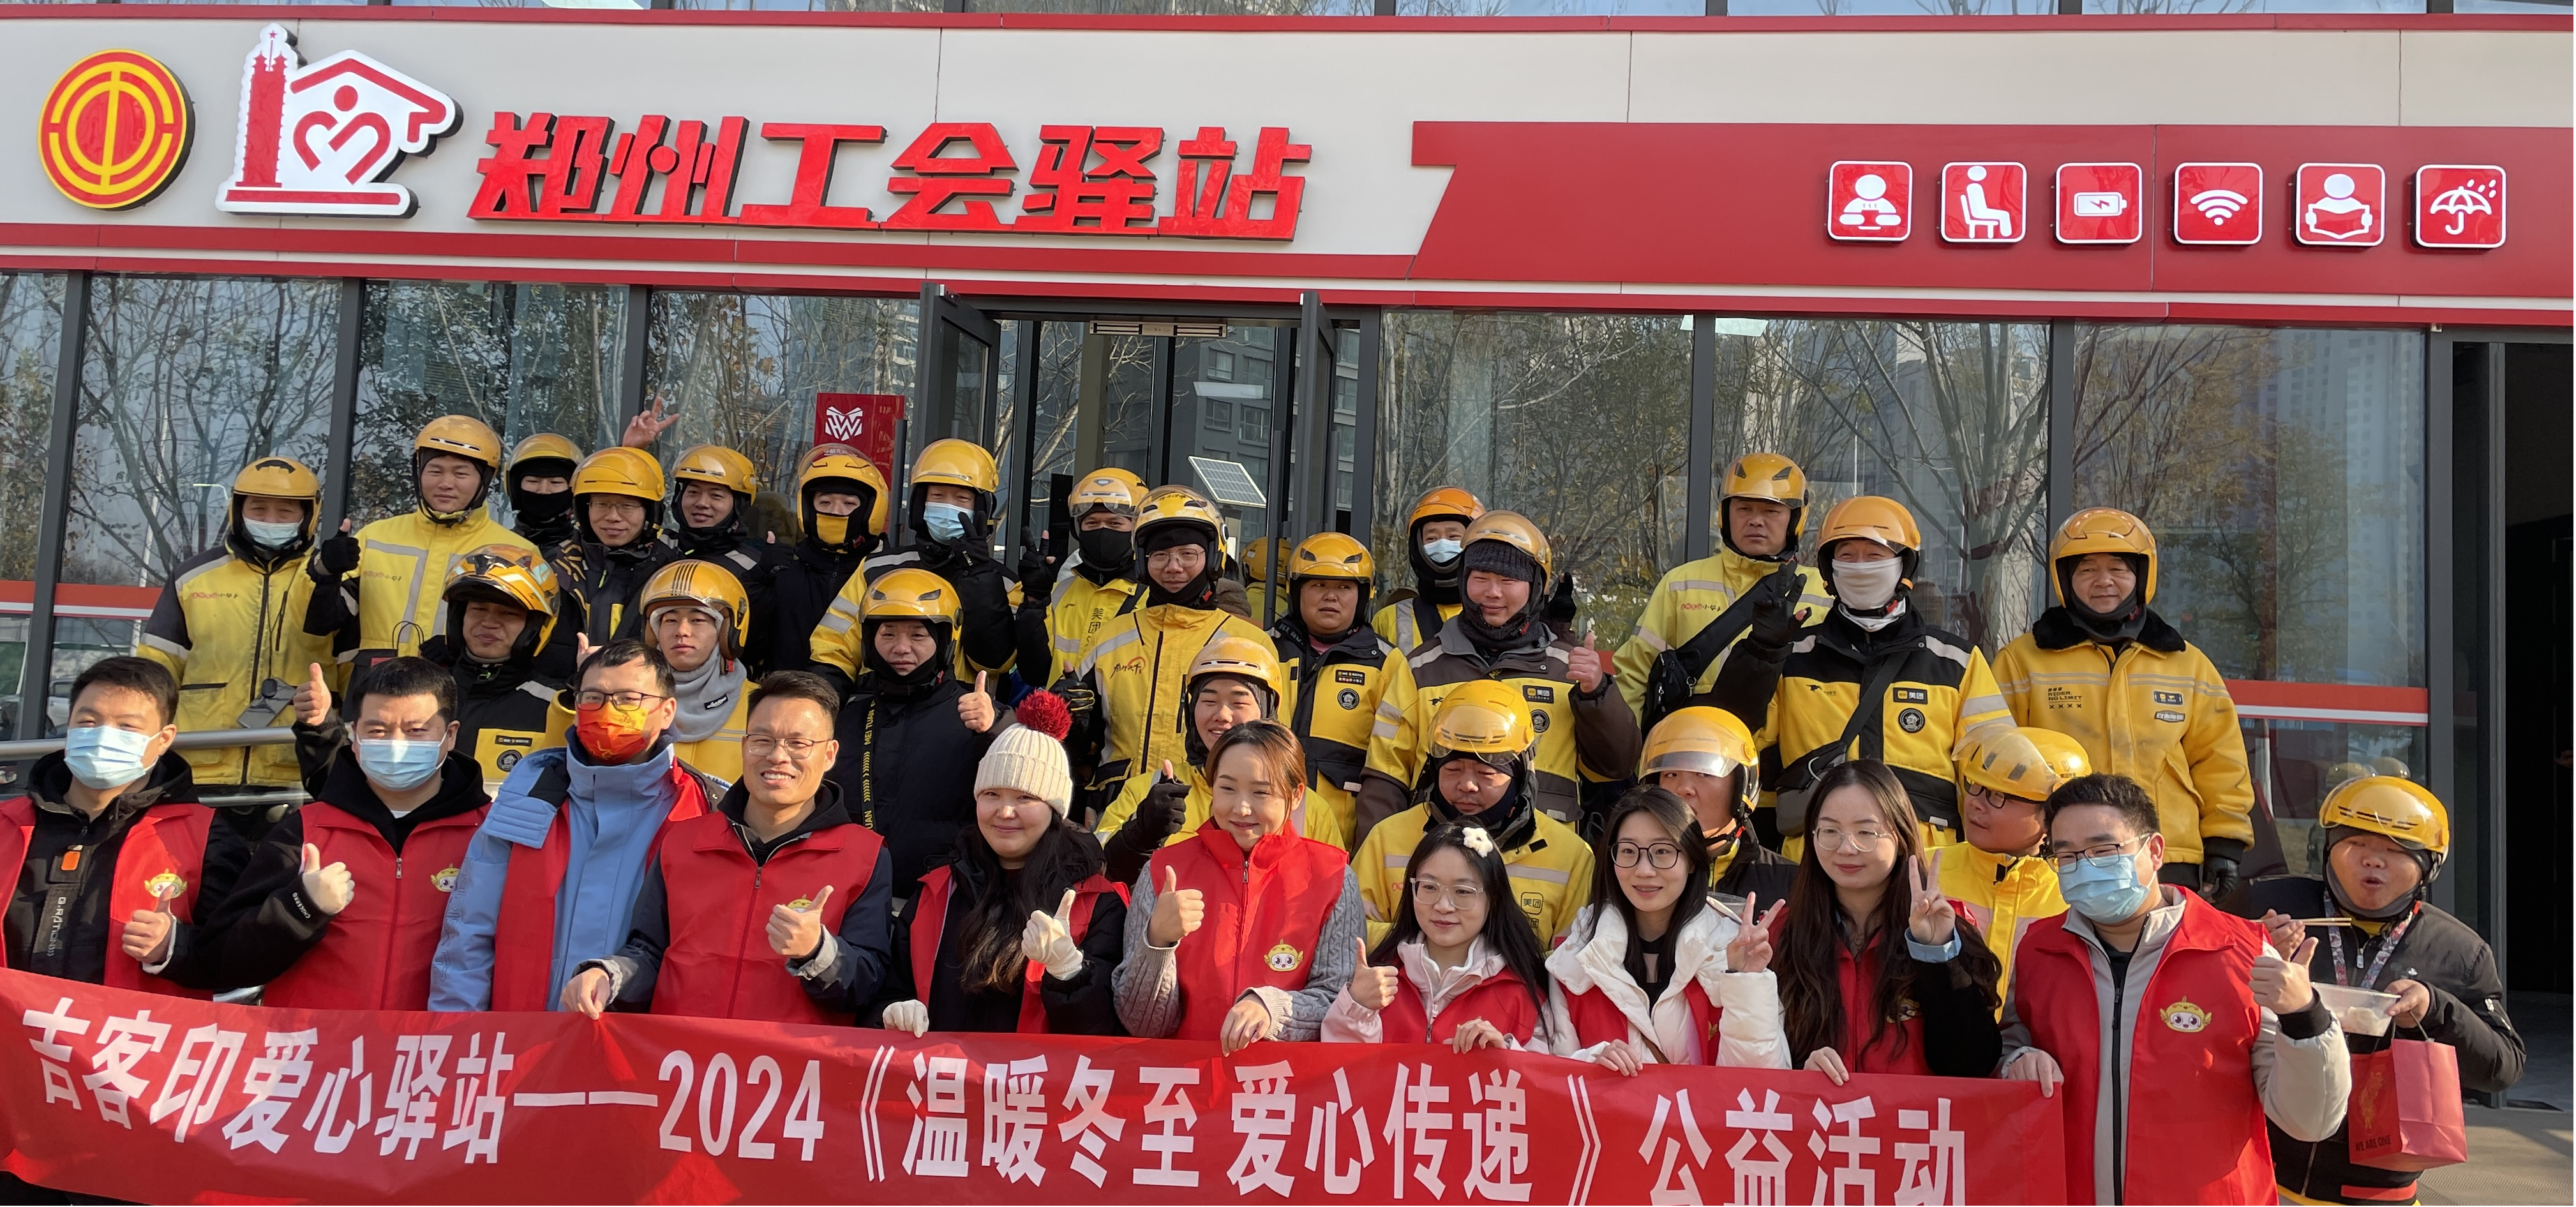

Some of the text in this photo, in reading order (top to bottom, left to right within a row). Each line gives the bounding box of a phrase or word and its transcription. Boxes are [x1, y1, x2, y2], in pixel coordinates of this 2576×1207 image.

[467, 110, 1311, 241] 郑州工会驿站
[1908, 691, 1924, 701] 美团
[864, 730, 872, 746] MEI
[864, 810, 874, 830] UAN
[1523, 898, 1541, 909] 美团
